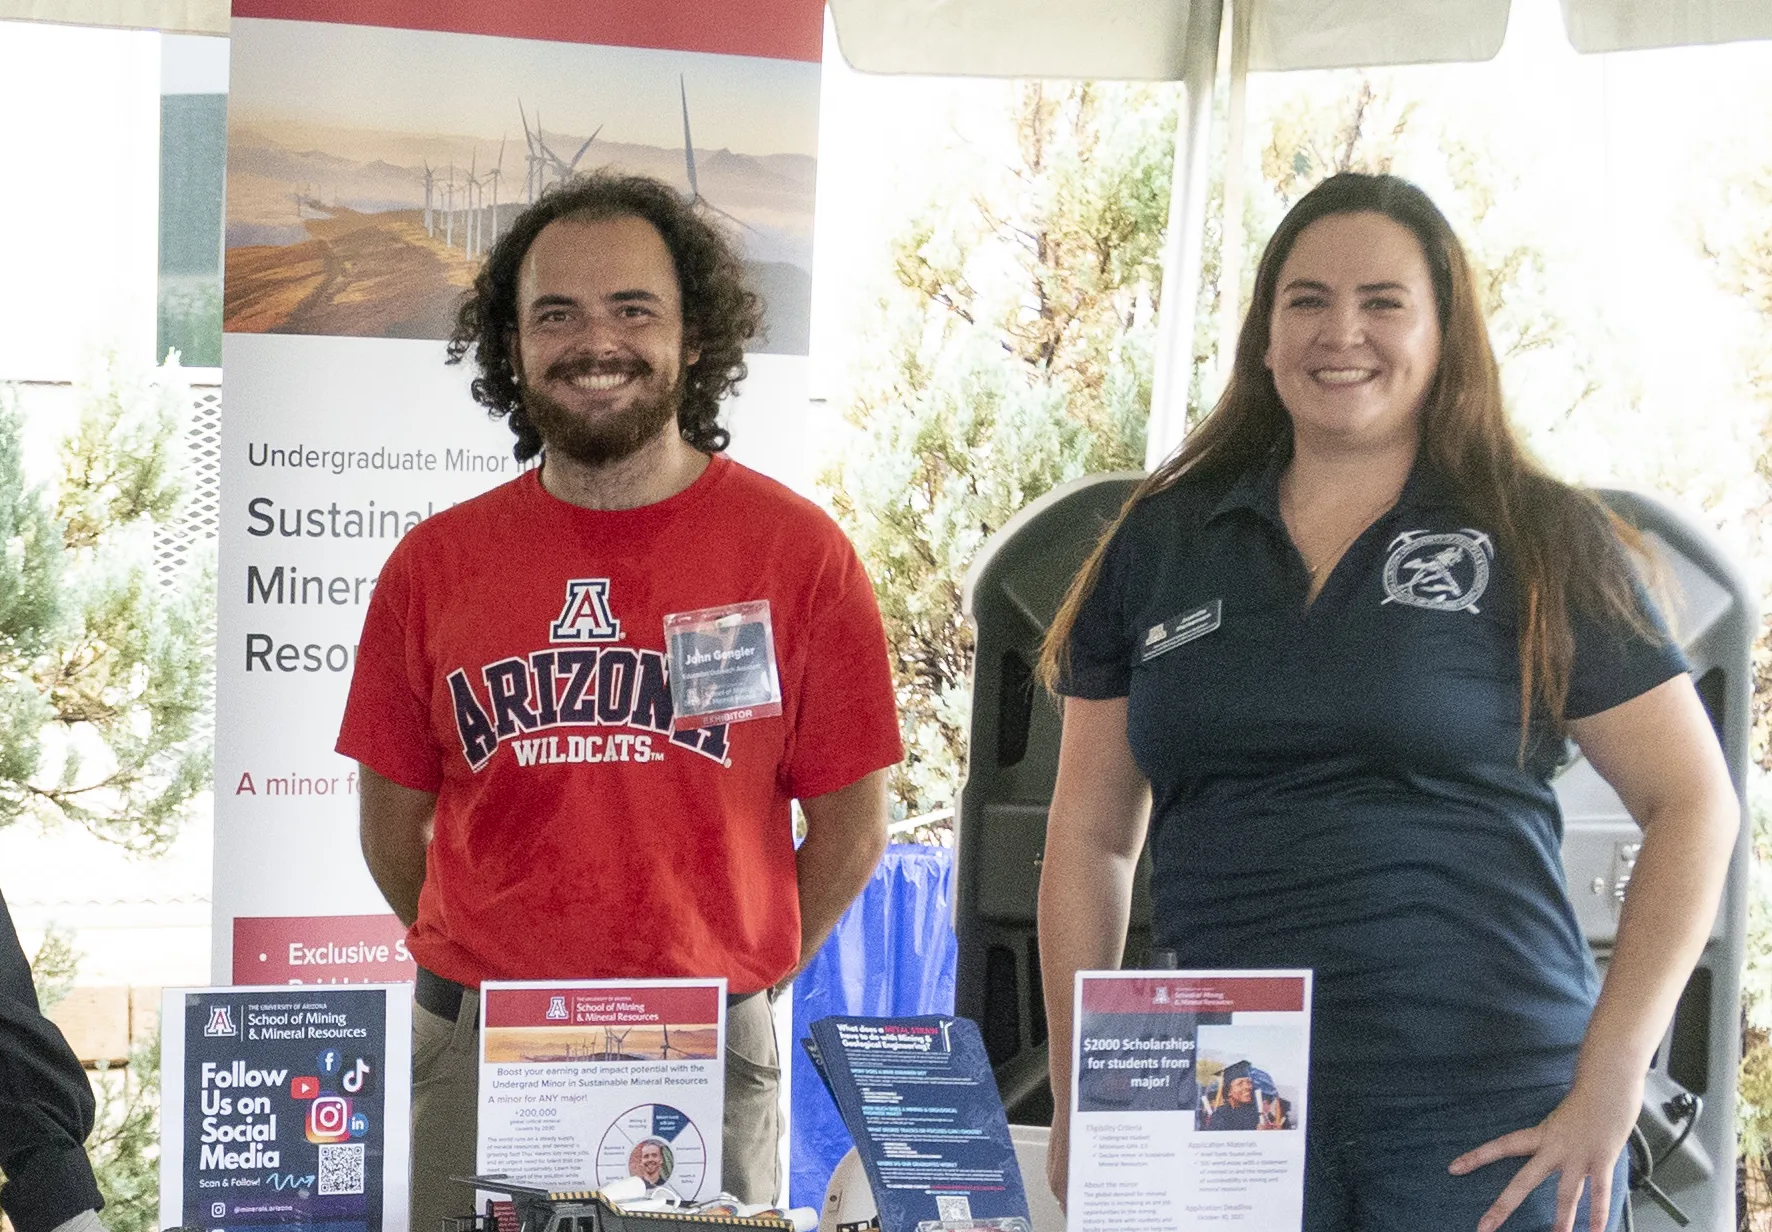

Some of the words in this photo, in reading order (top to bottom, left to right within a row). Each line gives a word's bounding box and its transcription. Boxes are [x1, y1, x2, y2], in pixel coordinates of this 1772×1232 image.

[248, 443, 437, 475] Undergraduate
[445, 448, 508, 472] Minor
[246, 497, 436, 538] Sustaina
[246, 633, 358, 672] Reso
[685, 646, 712, 666] John
[713, 646, 756, 661] Gengler
[703, 709, 753, 725] EXHIBITOR
[236, 772, 256, 795] A
[266, 772, 338, 795] minor
[289, 941, 388, 965] Exclusive
[576, 1003, 604, 1012] School
[606, 1003, 614, 1011] of
[616, 1003, 645, 1013] Mining
[248, 1013, 288, 1026] School
[291, 1013, 303, 1024] of
[305, 1012, 346, 1027] Mining
[576, 1013, 584, 1022] &
[585, 1013, 616, 1022] Mineral
[617, 1012, 659, 1021] Resources
[248, 1029, 259, 1040] &
[261, 1028, 304, 1040] Mineral
[308, 1027, 367, 1039] Resources
[1084, 1038, 1120, 1052] $2000
[1122, 1037, 1195, 1052] Scholarships
[497, 1067, 522, 1076] Boost
[524, 1068, 544, 1077] your
[546, 1067, 579, 1077] earning
[581, 1066, 597, 1074] and
[600, 1065, 628, 1075] impact
[630, 1064, 668, 1075] potential
[670, 1064, 688, 1072] with
[690, 1064, 704, 1072] the
[1088, 1057, 1105, 1069] for
[1107, 1057, 1158, 1069] students
[1161, 1057, 1190, 1068] from
[201, 1060, 288, 1088] Follow
[493, 1080, 539, 1090] Undergrad
[541, 1080, 566, 1088] Minor
[568, 1079, 576, 1087] in
[578, 1078, 628, 1087] Sustainable
[630, 1078, 663, 1086] Mineral
[664, 1077, 708, 1085] Resources
[1130, 1075, 1170, 1090] major!
[201, 1089, 233, 1116] Us
[237, 1096, 271, 1115] on
[497, 1095, 522, 1103] minor
[524, 1095, 536, 1103] for
[560, 1094, 588, 1104] major!
[200, 1114, 277, 1143] Social
[200, 1142, 281, 1170] Media
[199, 1178, 220, 1188] Scan
[222, 1178, 229, 1187] &
[230, 1177, 261, 1187] Follow!
